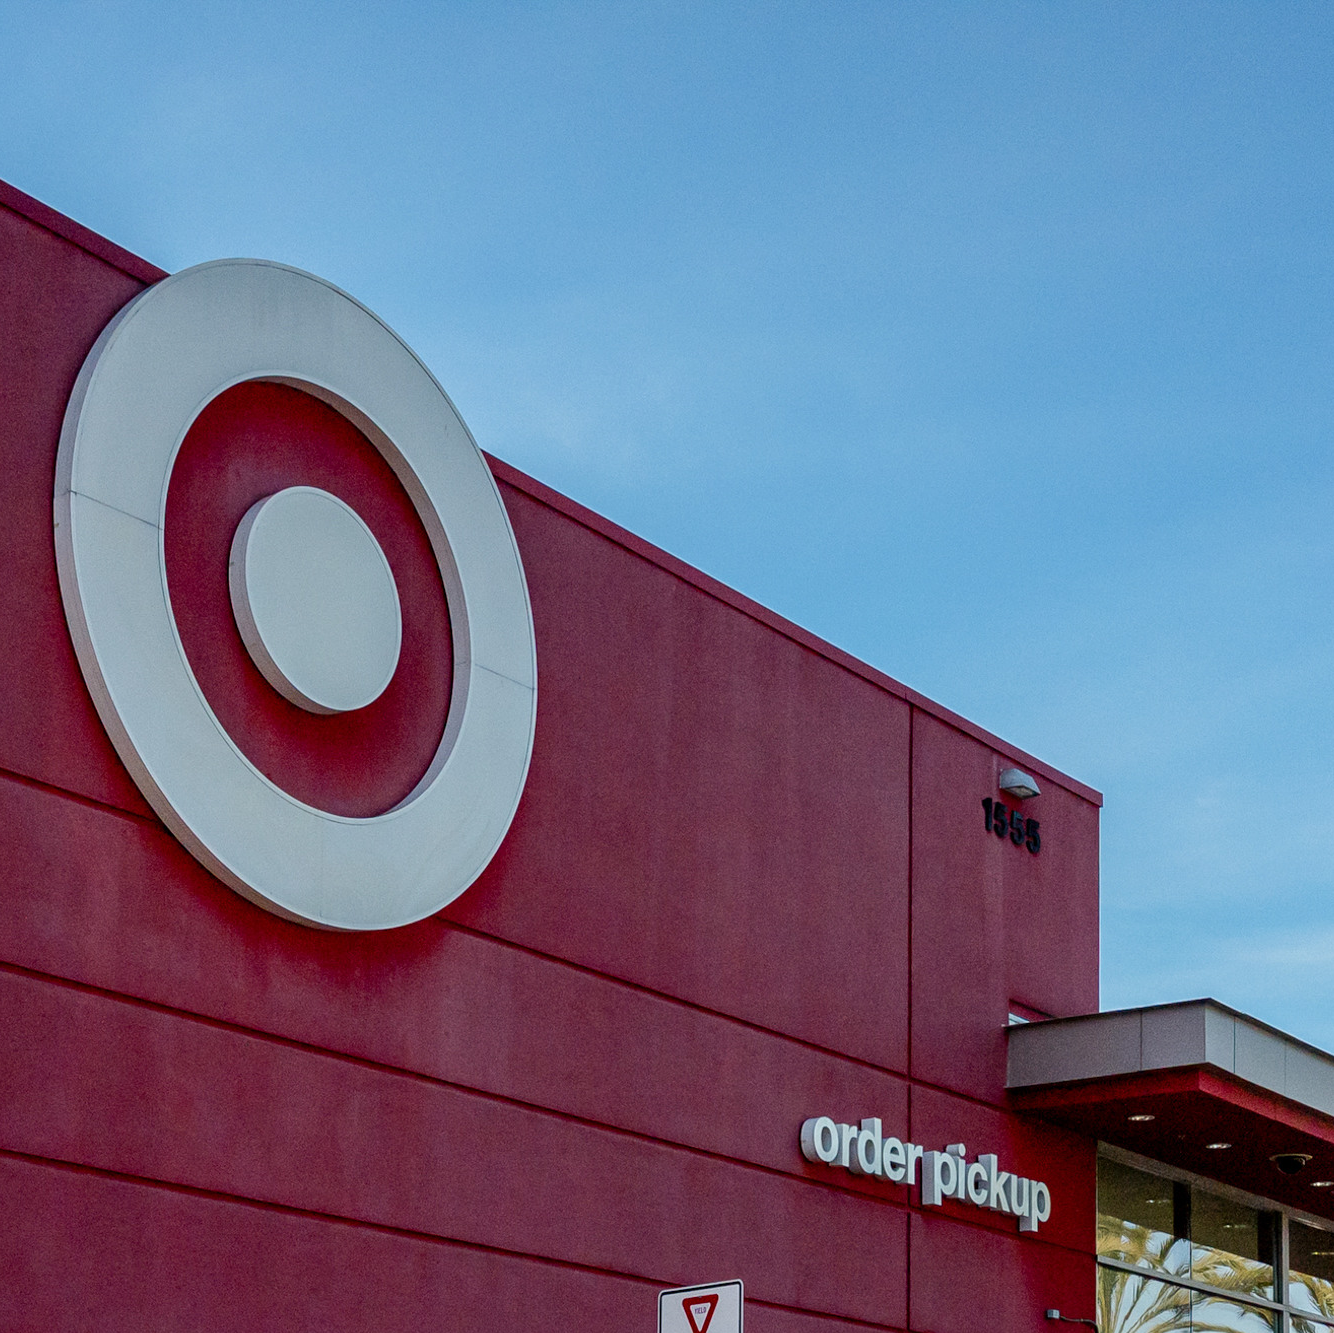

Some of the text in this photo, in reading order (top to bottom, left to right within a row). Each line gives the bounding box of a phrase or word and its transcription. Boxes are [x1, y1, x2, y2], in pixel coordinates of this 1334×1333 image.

[981, 797, 1040, 853] 1555
[800, 1116, 1051, 1232] order pickup
